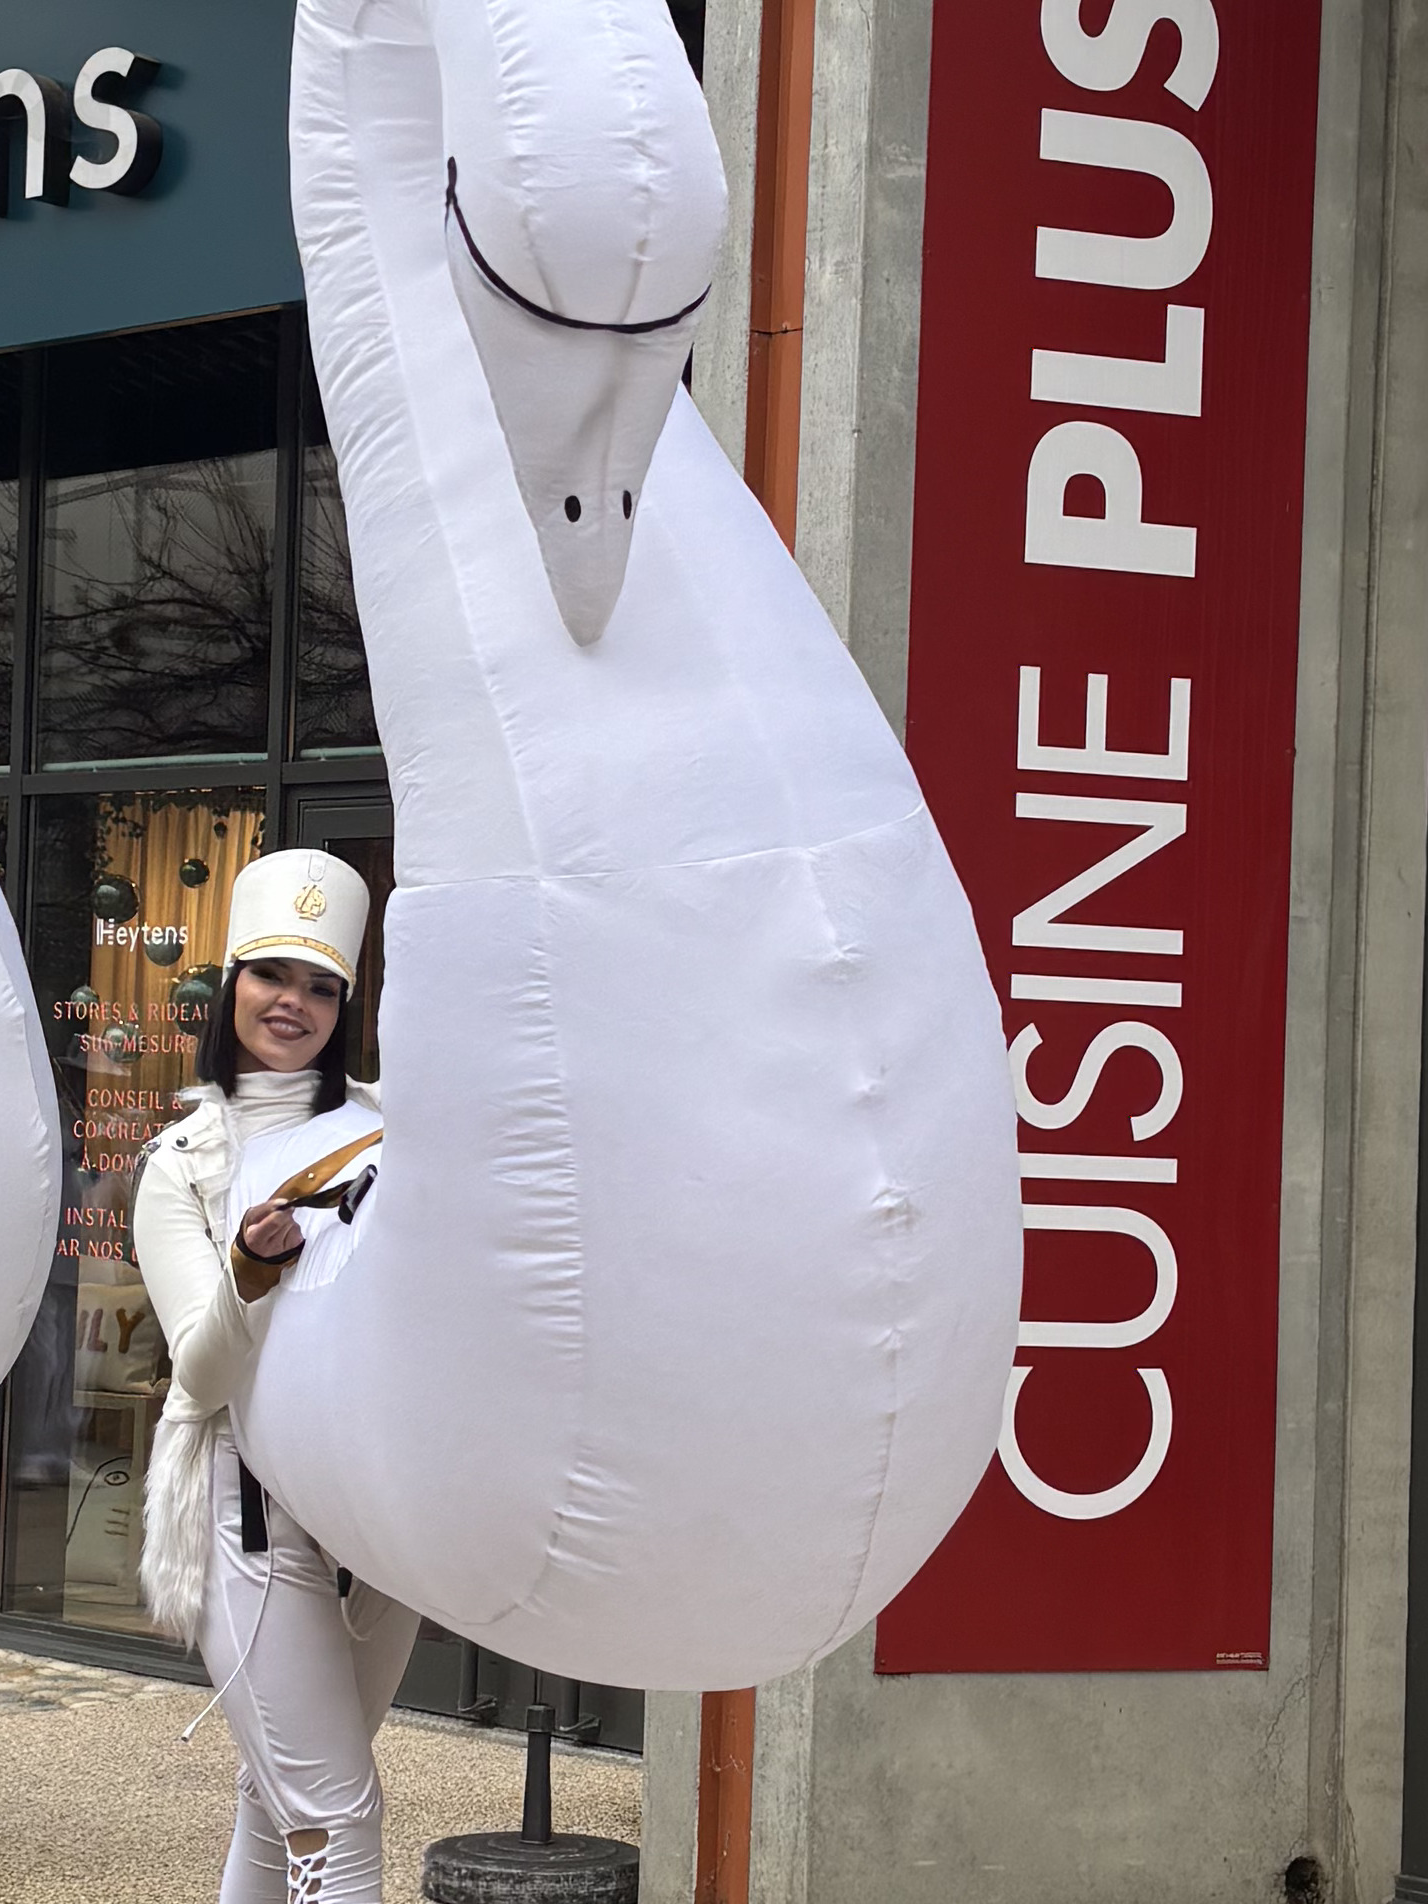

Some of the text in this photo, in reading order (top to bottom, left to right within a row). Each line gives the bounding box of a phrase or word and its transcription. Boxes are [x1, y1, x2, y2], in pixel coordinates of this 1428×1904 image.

[96, 917, 189, 953] Heytens
[53, 1001, 122, 1021] STORES
[128, 1002, 139, 1021] &
[87, 1088, 164, 1110] CONSEIL
[997, 665, 1192, 1520] CUISINE
[88, 1240, 124, 1261] NOS
